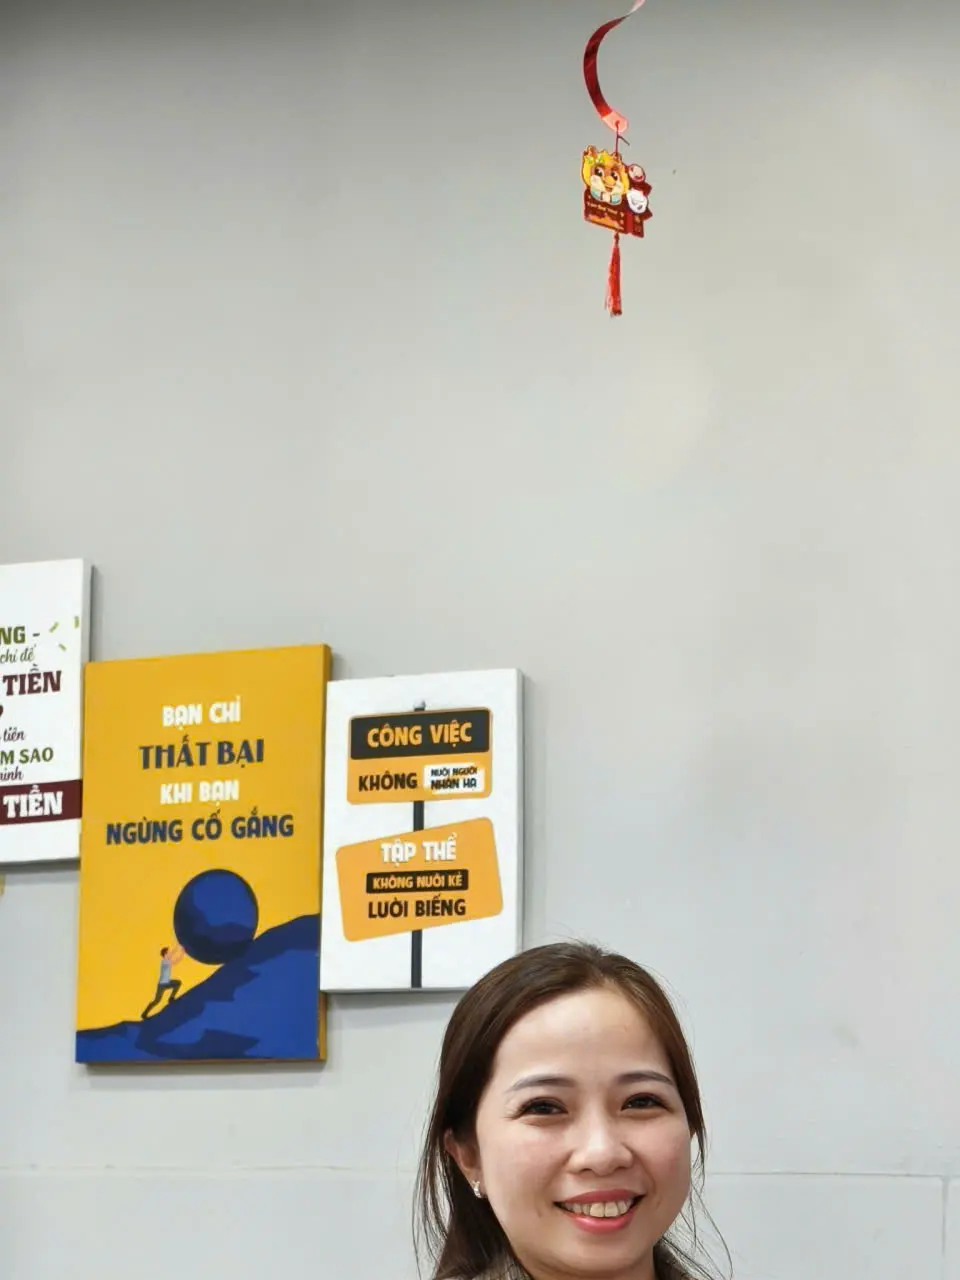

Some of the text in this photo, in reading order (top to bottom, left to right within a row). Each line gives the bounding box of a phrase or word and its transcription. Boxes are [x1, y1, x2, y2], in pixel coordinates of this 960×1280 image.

[3, 663, 62, 697] TIỀN
[162, 695, 241, 731] BẠN CHỈ
[367, 719, 473, 748] CÔNG VIỆC
[19, 747, 54, 764] SAO
[139, 734, 264, 770] THẤT BẠI
[160, 779, 240, 806] KHI BẠN
[358, 770, 418, 792] KHÔNG
[191, 809, 222, 841] CỐ
[231, 806, 294, 839] GẮNG
[380, 832, 457, 867] TẬP THỂ
[372, 871, 463, 890] KHÔNG NUÔI KẺ
[415, 893, 467, 917] BIẾNG
